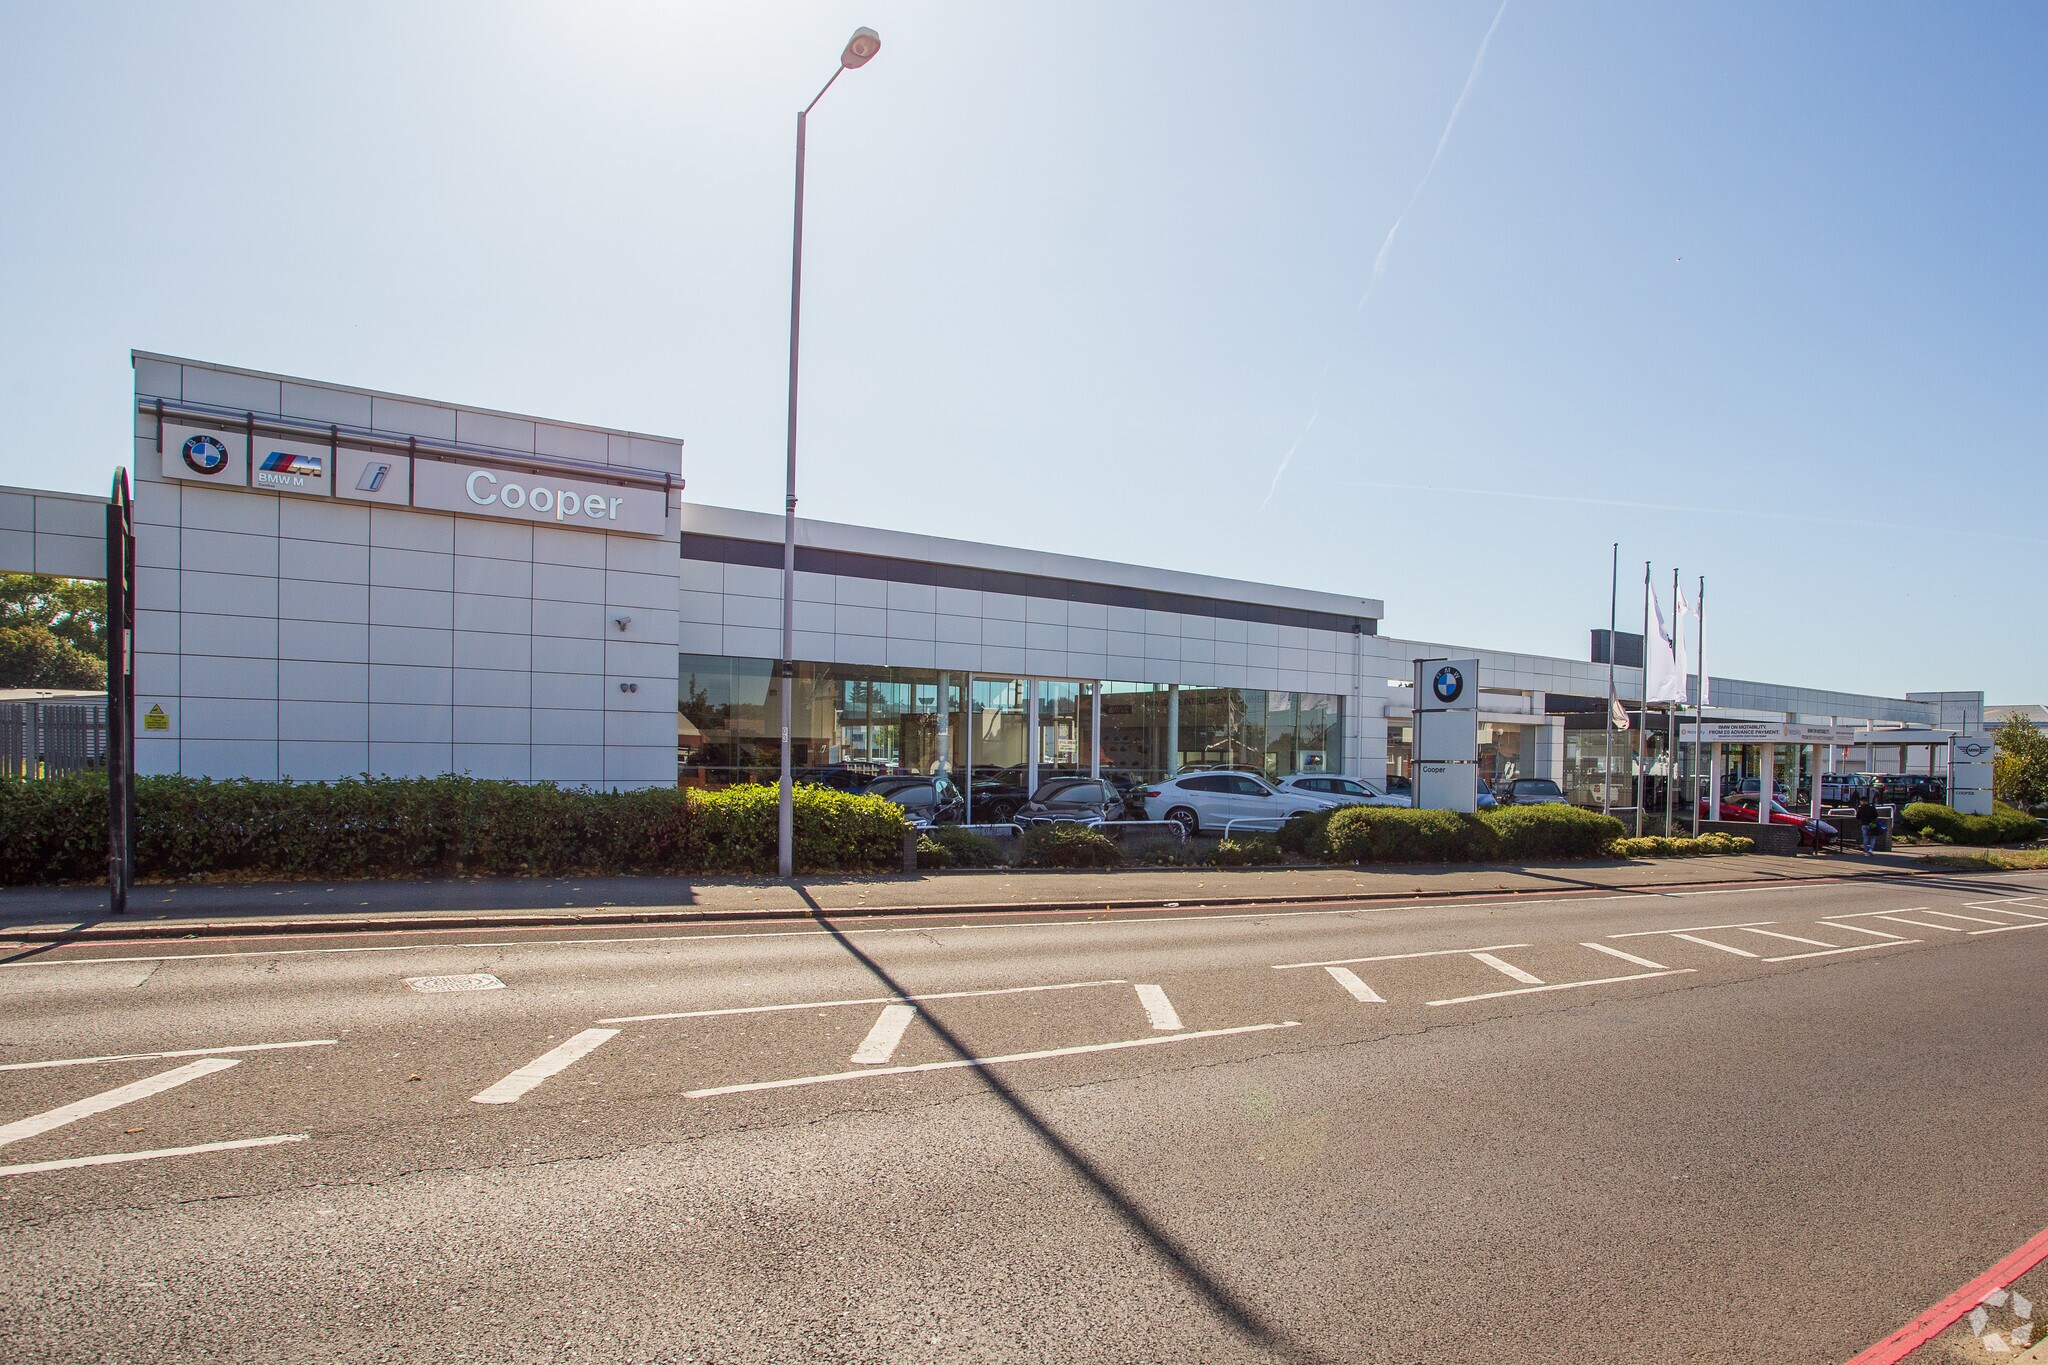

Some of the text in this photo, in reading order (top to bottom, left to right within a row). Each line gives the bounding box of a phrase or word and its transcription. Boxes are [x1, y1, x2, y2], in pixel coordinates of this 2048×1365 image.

[187, 436, 225, 451] BMW
[258, 472, 305, 487] BMW M
[465, 470, 624, 521] Cooper
[1422, 766, 1446, 774] Cooper
